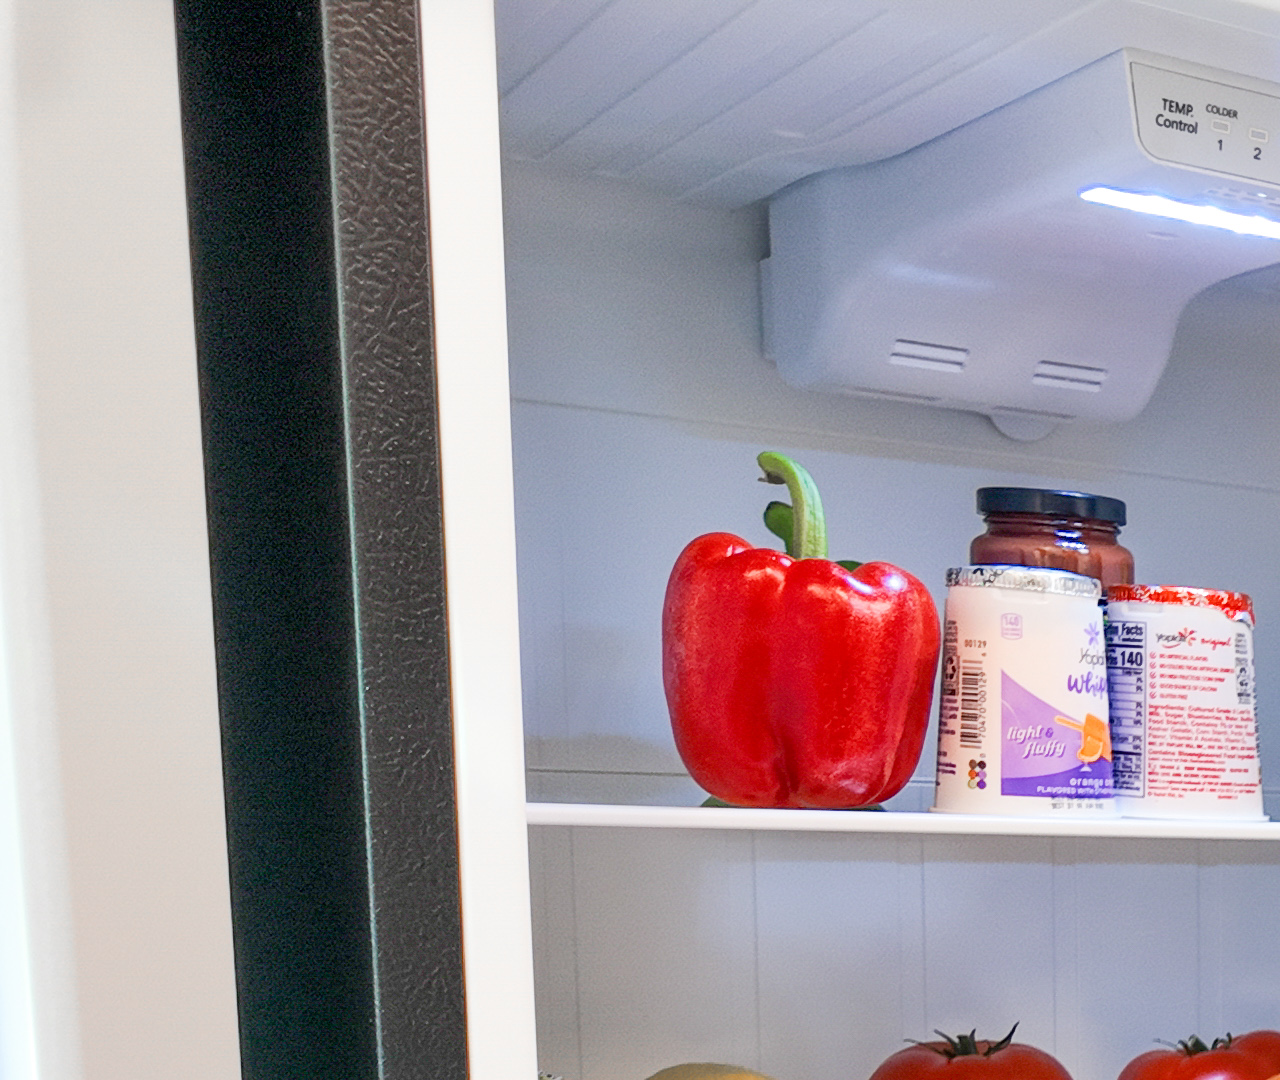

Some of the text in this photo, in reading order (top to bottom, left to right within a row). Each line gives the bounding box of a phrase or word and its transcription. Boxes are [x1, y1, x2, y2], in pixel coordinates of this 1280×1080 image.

[1162, 98, 1194, 118] TEMP.
[1205, 103, 1238, 119] COLDER
[1155, 113, 1198, 134] Control
[1217, 139, 1223, 151] 1
[1253, 147, 1262, 160] 2
[1120, 651, 1143, 667] 140
[1006, 726, 1042, 745] light
[1022, 740, 1066, 758] fluffy
